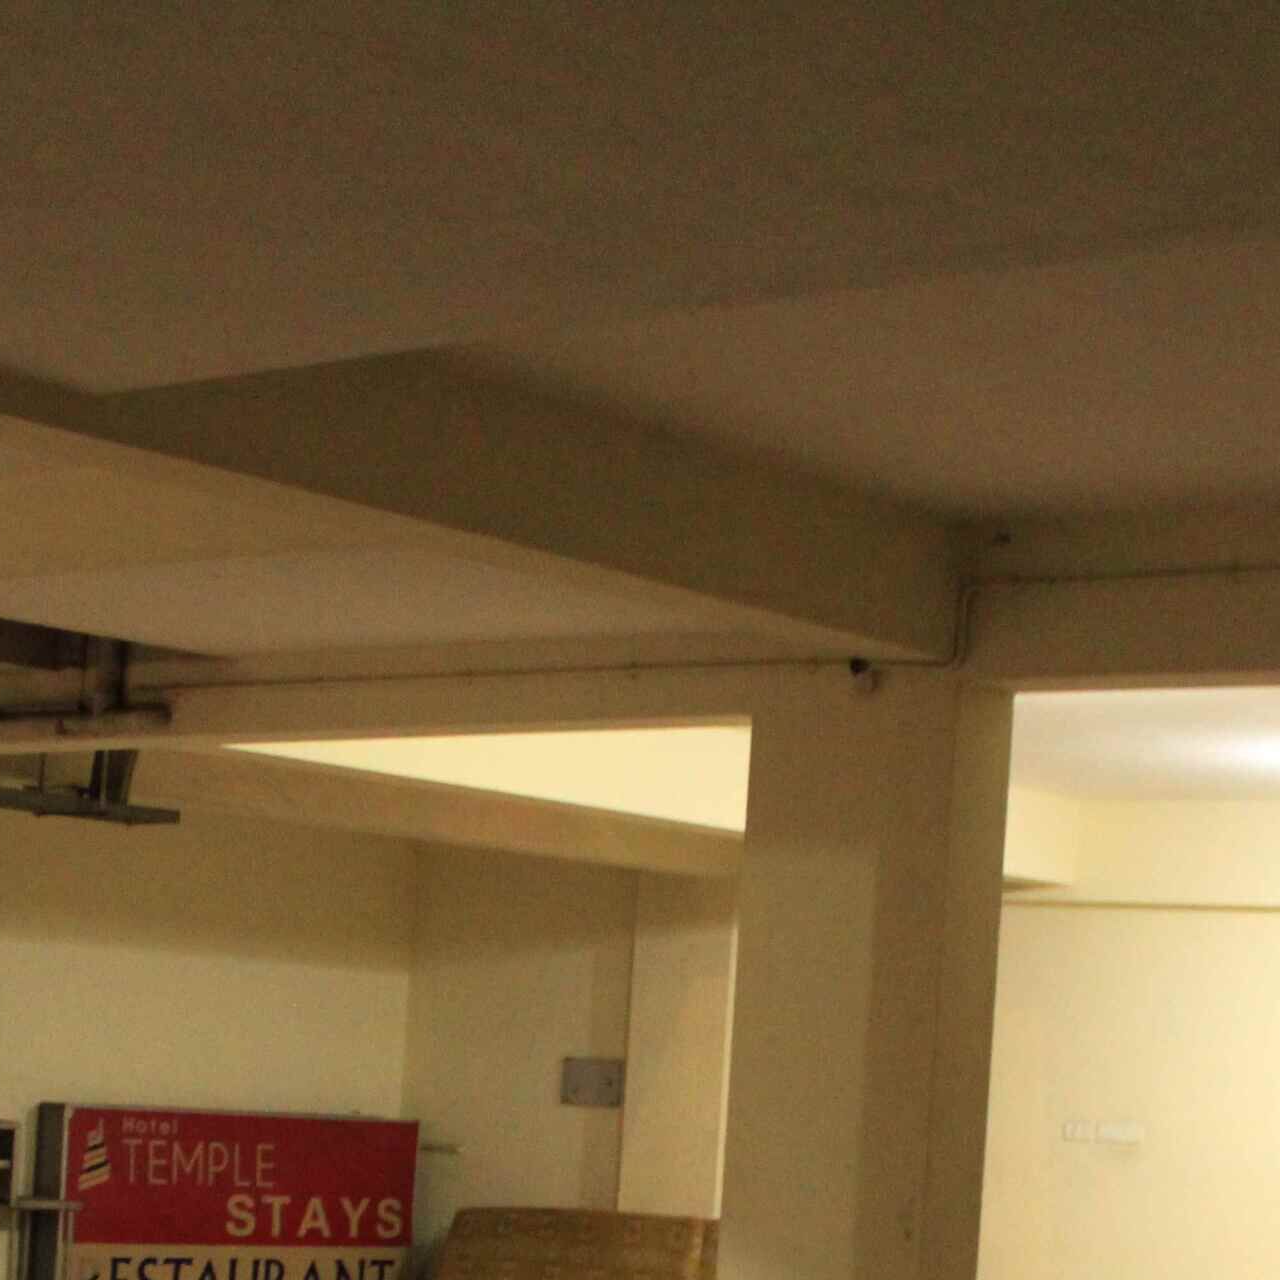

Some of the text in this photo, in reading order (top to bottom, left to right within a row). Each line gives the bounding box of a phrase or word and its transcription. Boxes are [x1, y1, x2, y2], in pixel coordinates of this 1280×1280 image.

[122, 1117, 180, 1135] Hotel
[122, 1138, 275, 1188] TEMPLE
[225, 1194, 403, 1239] STAYS
